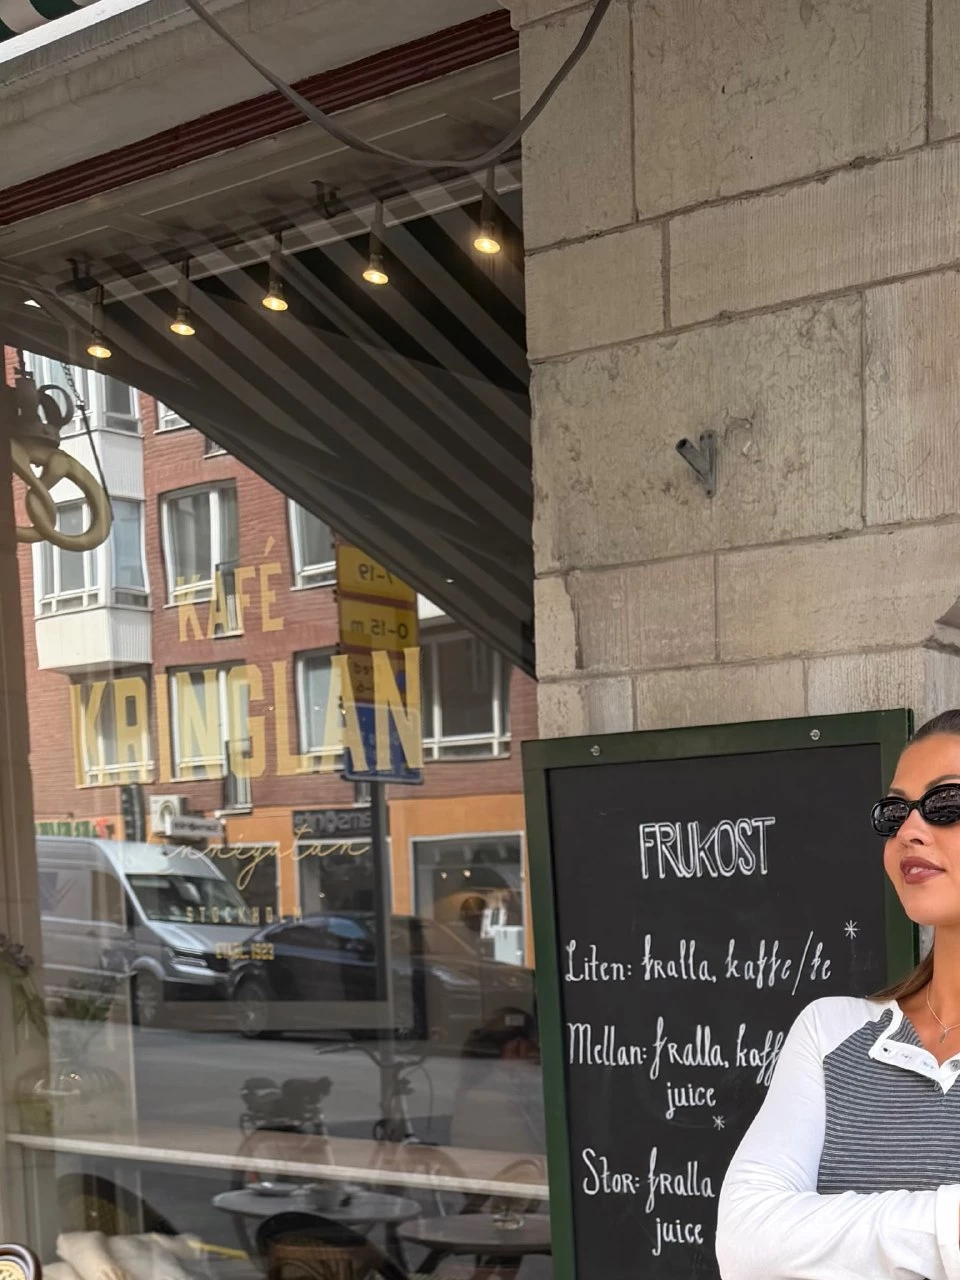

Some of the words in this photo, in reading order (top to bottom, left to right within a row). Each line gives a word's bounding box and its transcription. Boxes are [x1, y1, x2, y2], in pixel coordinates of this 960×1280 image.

[177, 536, 284, 642] KAFÉ
[70, 646, 424, 790] KRINGLAN
[639, 816, 776, 879] FRUKOST
[565, 940, 632, 981] Liten:
[567, 1022, 648, 1066] Mellan:
[736, 1022, 784, 1087] kaff
[665, 1082, 717, 1119] juice
[582, 1148, 640, 1195] Stor:
[652, 1217, 704, 1256] juice
